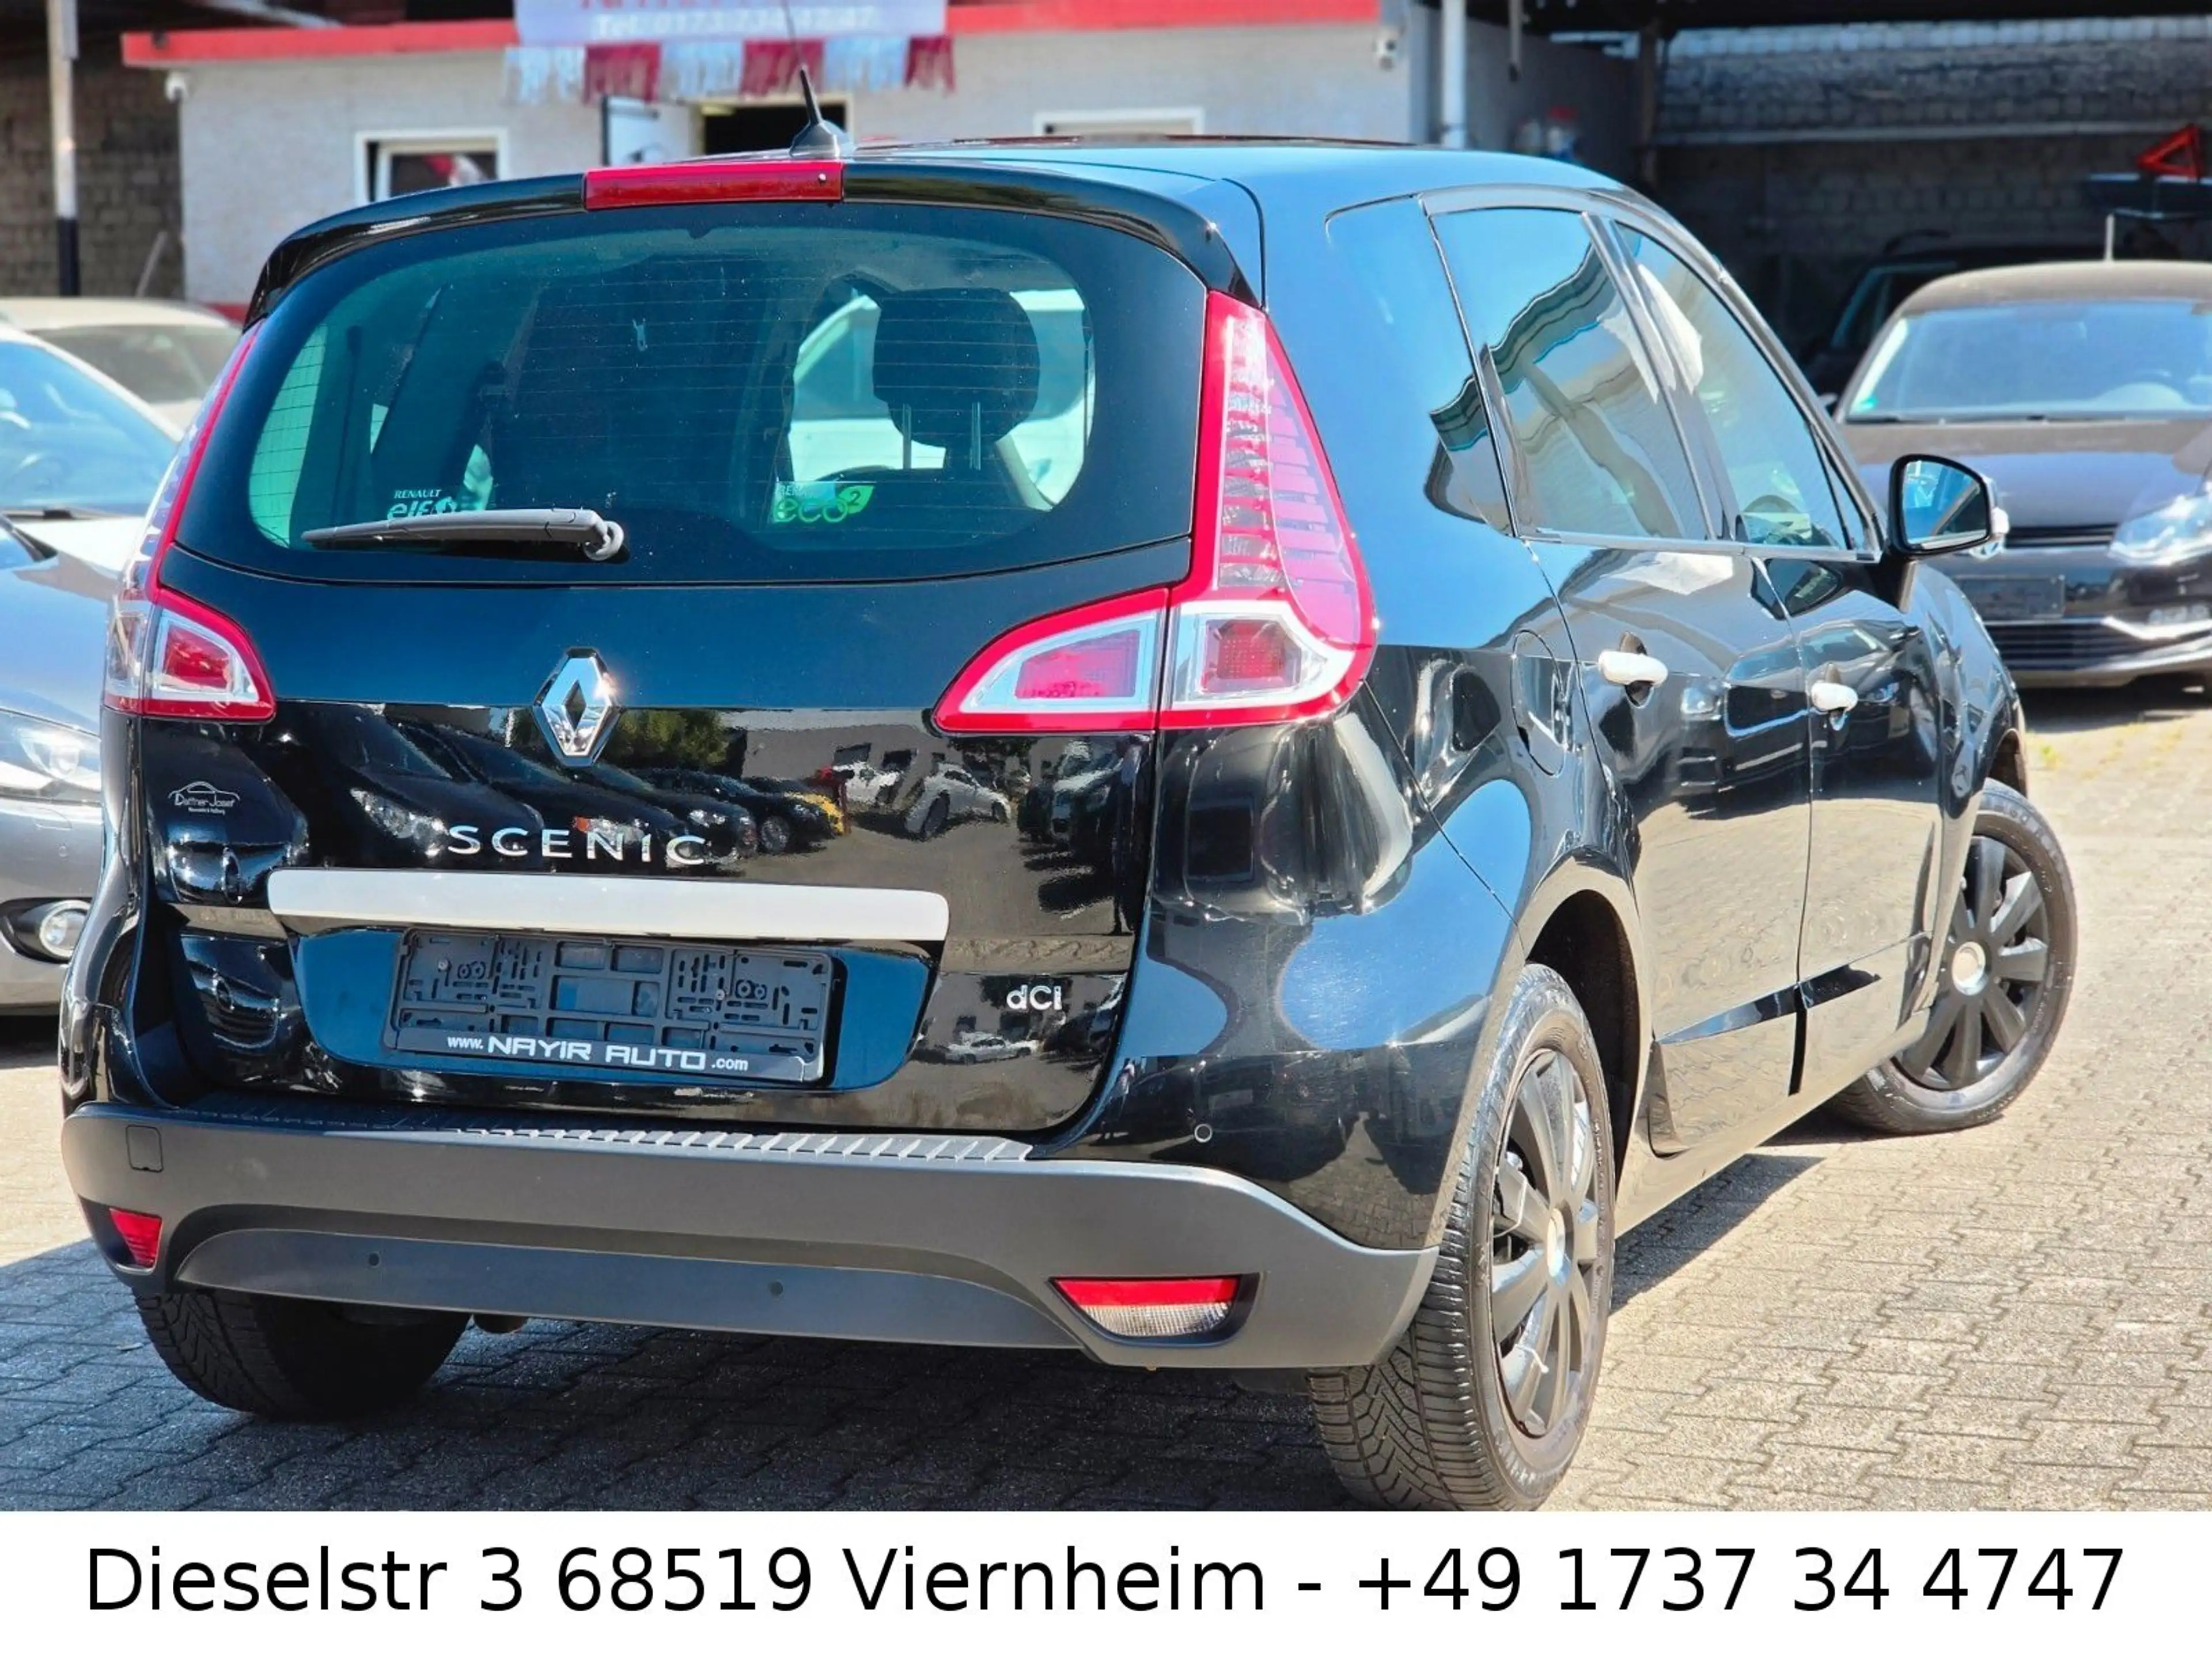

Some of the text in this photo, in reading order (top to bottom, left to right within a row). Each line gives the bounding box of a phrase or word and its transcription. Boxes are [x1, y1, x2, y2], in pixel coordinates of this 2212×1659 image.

[394, 489, 442, 499] RENAULT
[448, 825, 706, 865] SCENIC
[447, 1036, 749, 1071] www. NAYIR AUTO .com
